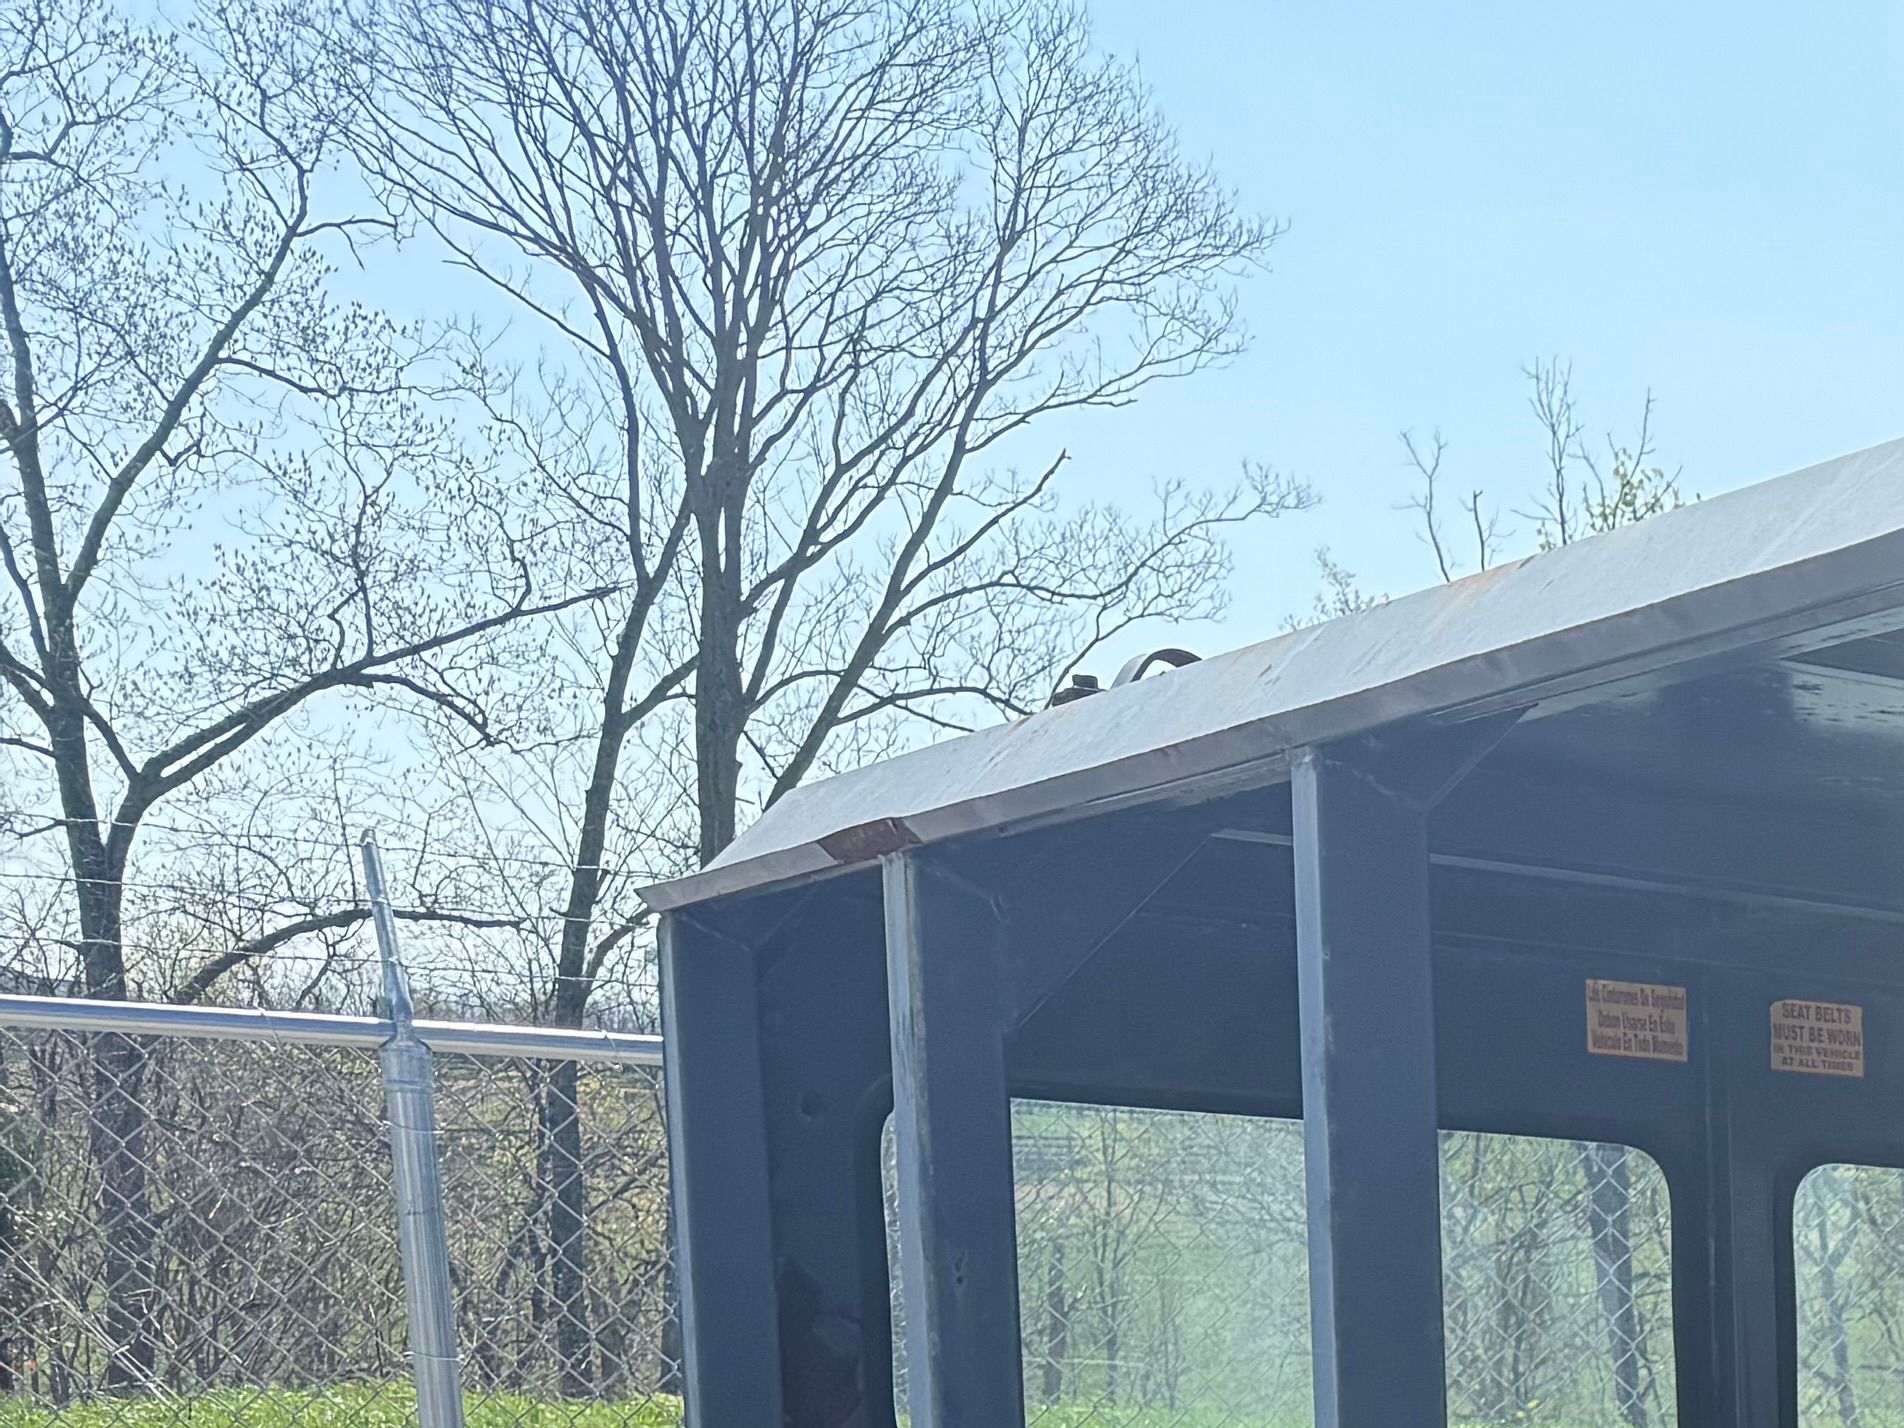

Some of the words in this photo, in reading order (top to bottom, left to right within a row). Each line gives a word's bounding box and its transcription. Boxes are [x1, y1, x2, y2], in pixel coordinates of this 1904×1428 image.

[1782, 1003, 1810, 1020] SEAT
[1815, 1006, 1852, 1024] BELTS
[1773, 1023, 1805, 1041] MUST
[1808, 1026, 1824, 1043] BE
[1826, 1028, 1862, 1047] WORN
[1782, 1056, 1794, 1066] AT
[1798, 1058, 1819, 1069] ALL
[1821, 1060, 1854, 1071] TIMES
